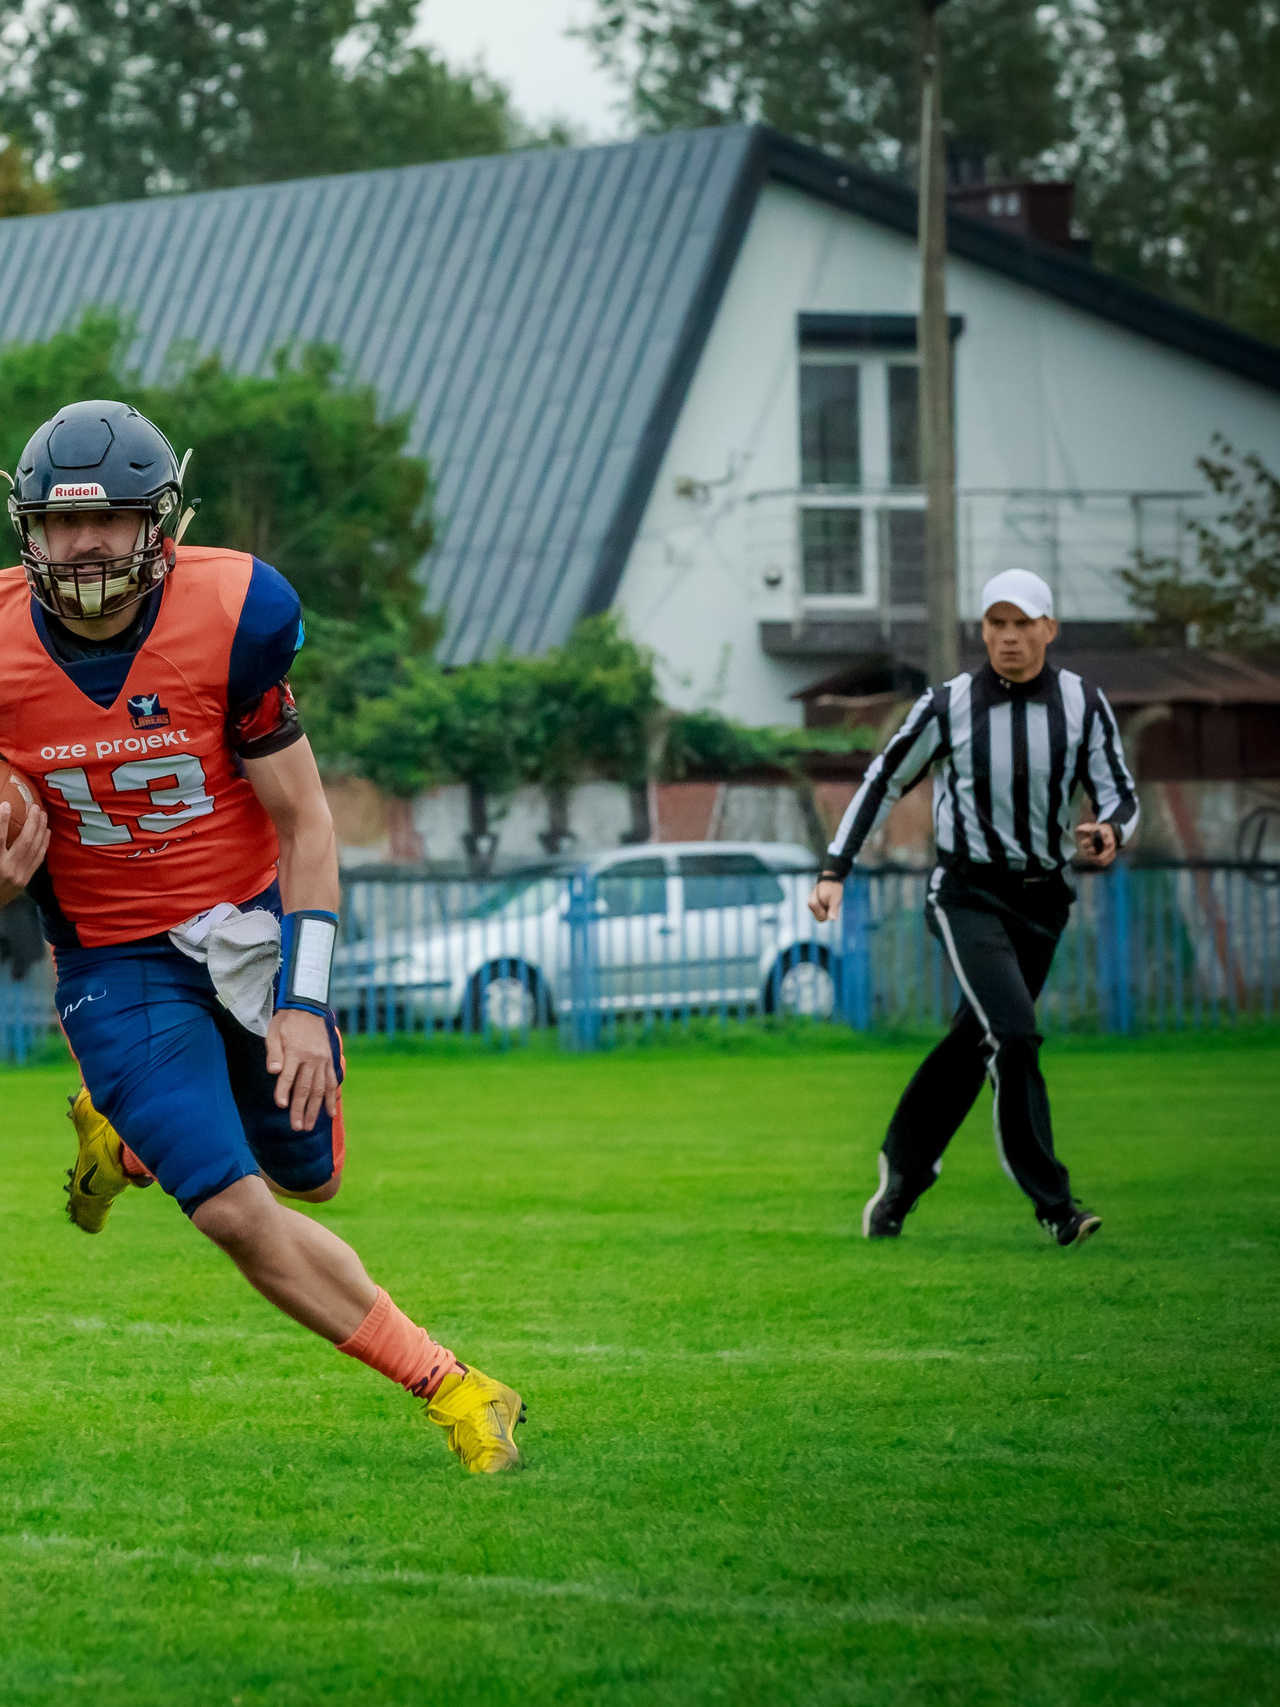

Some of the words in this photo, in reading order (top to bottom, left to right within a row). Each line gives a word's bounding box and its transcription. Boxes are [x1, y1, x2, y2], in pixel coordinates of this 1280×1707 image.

[55, 486, 98, 497] Riddell
[28, 540, 49, 561] ddell
[44, 752, 216, 846] 13
